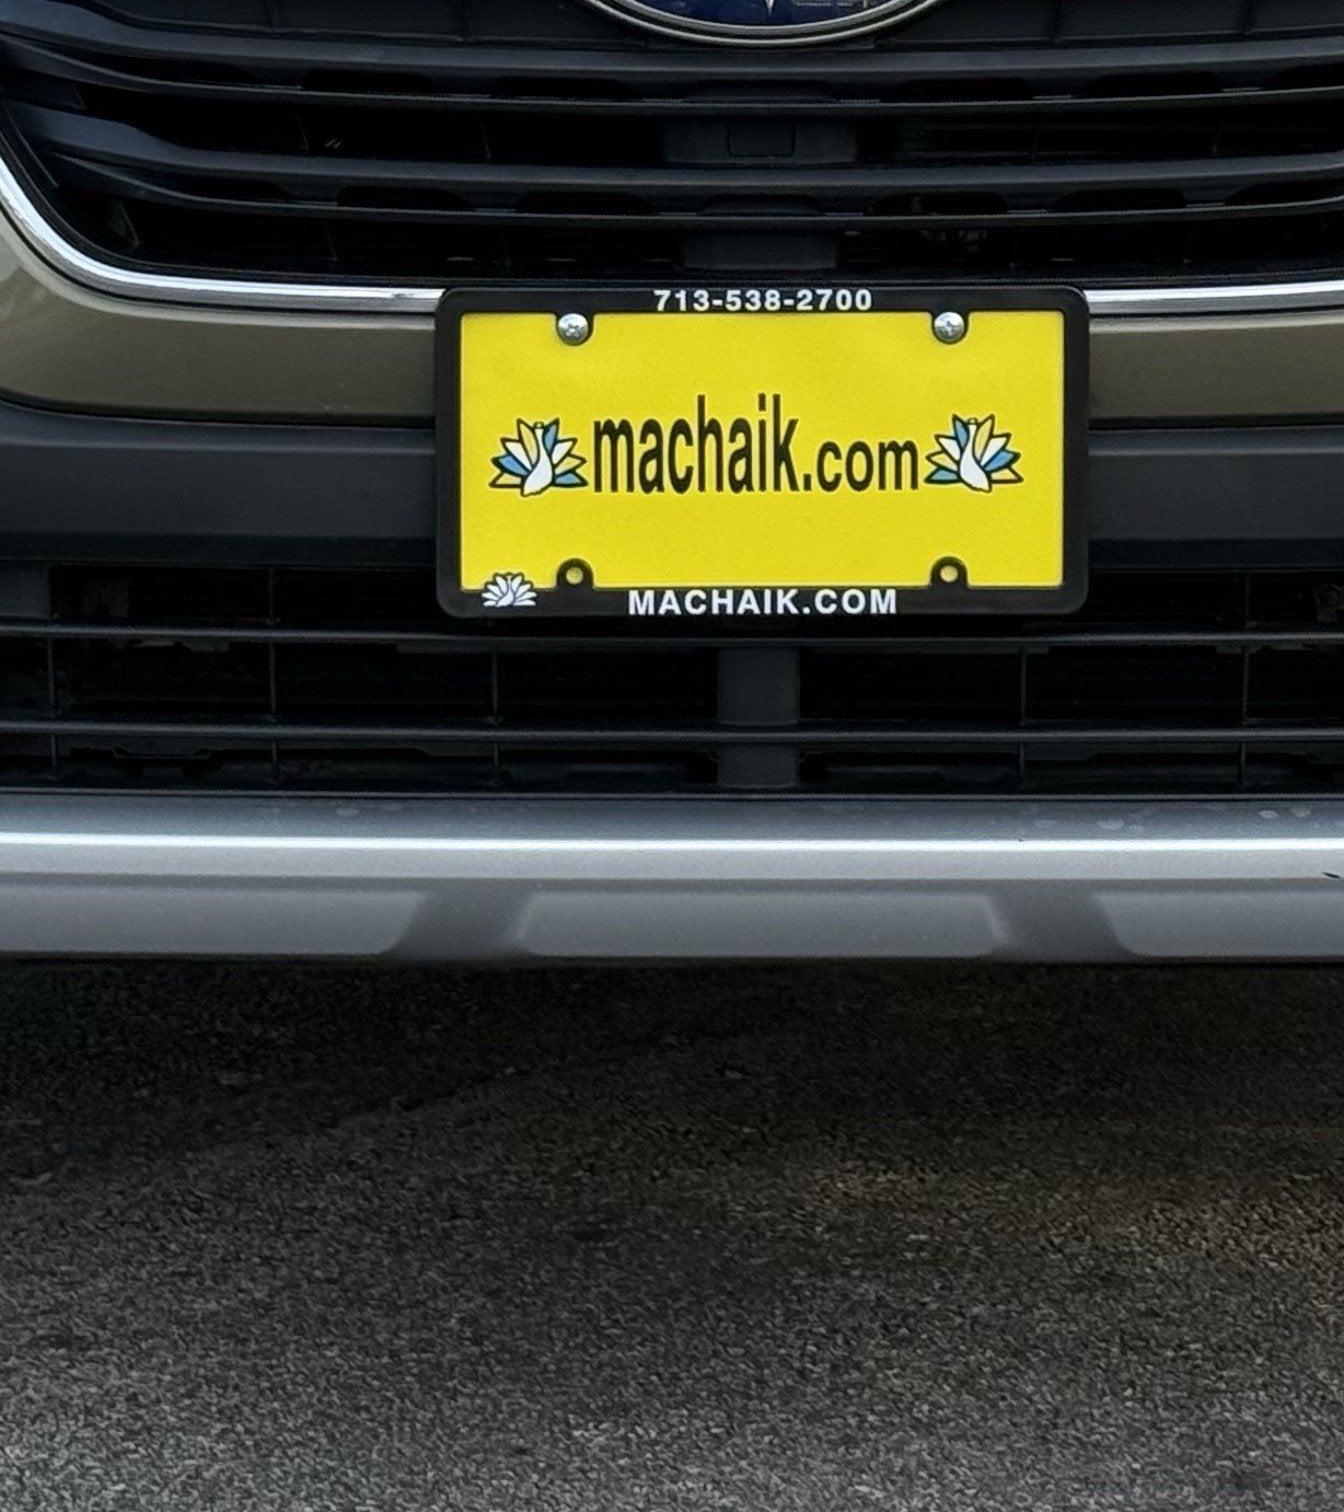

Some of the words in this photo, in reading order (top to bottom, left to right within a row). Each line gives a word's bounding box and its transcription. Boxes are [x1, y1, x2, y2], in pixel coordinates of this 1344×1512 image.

[653, 289, 873, 313] 713-538-2700
[592, 393, 919, 494] machaik.com
[628, 589, 898, 616] MACHAIK.COM
